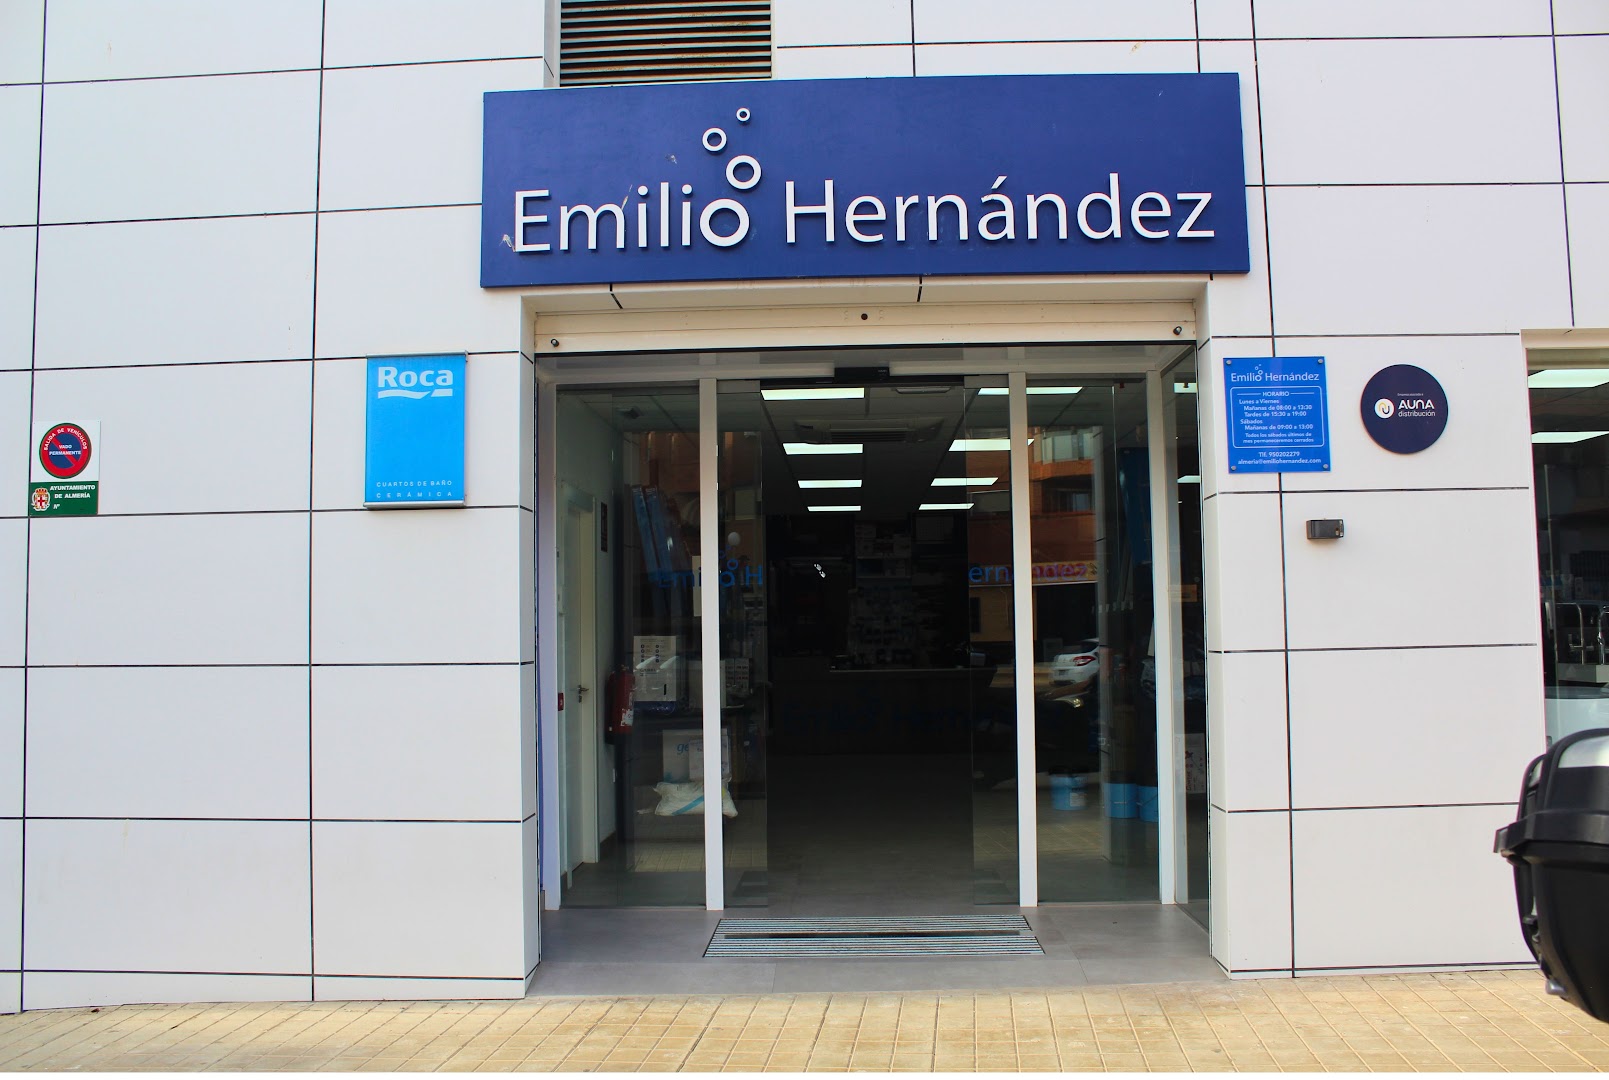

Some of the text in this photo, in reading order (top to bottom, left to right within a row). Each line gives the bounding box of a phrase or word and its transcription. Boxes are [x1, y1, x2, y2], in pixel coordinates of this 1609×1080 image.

[513, 172, 1215, 253] Emilio Hernández
[377, 366, 454, 388] Roca
[1231, 371, 1320, 382] Emilio Hernández
[43, 432, 57, 451] SALIDA
[430, 479, 452, 487] BAÑO
